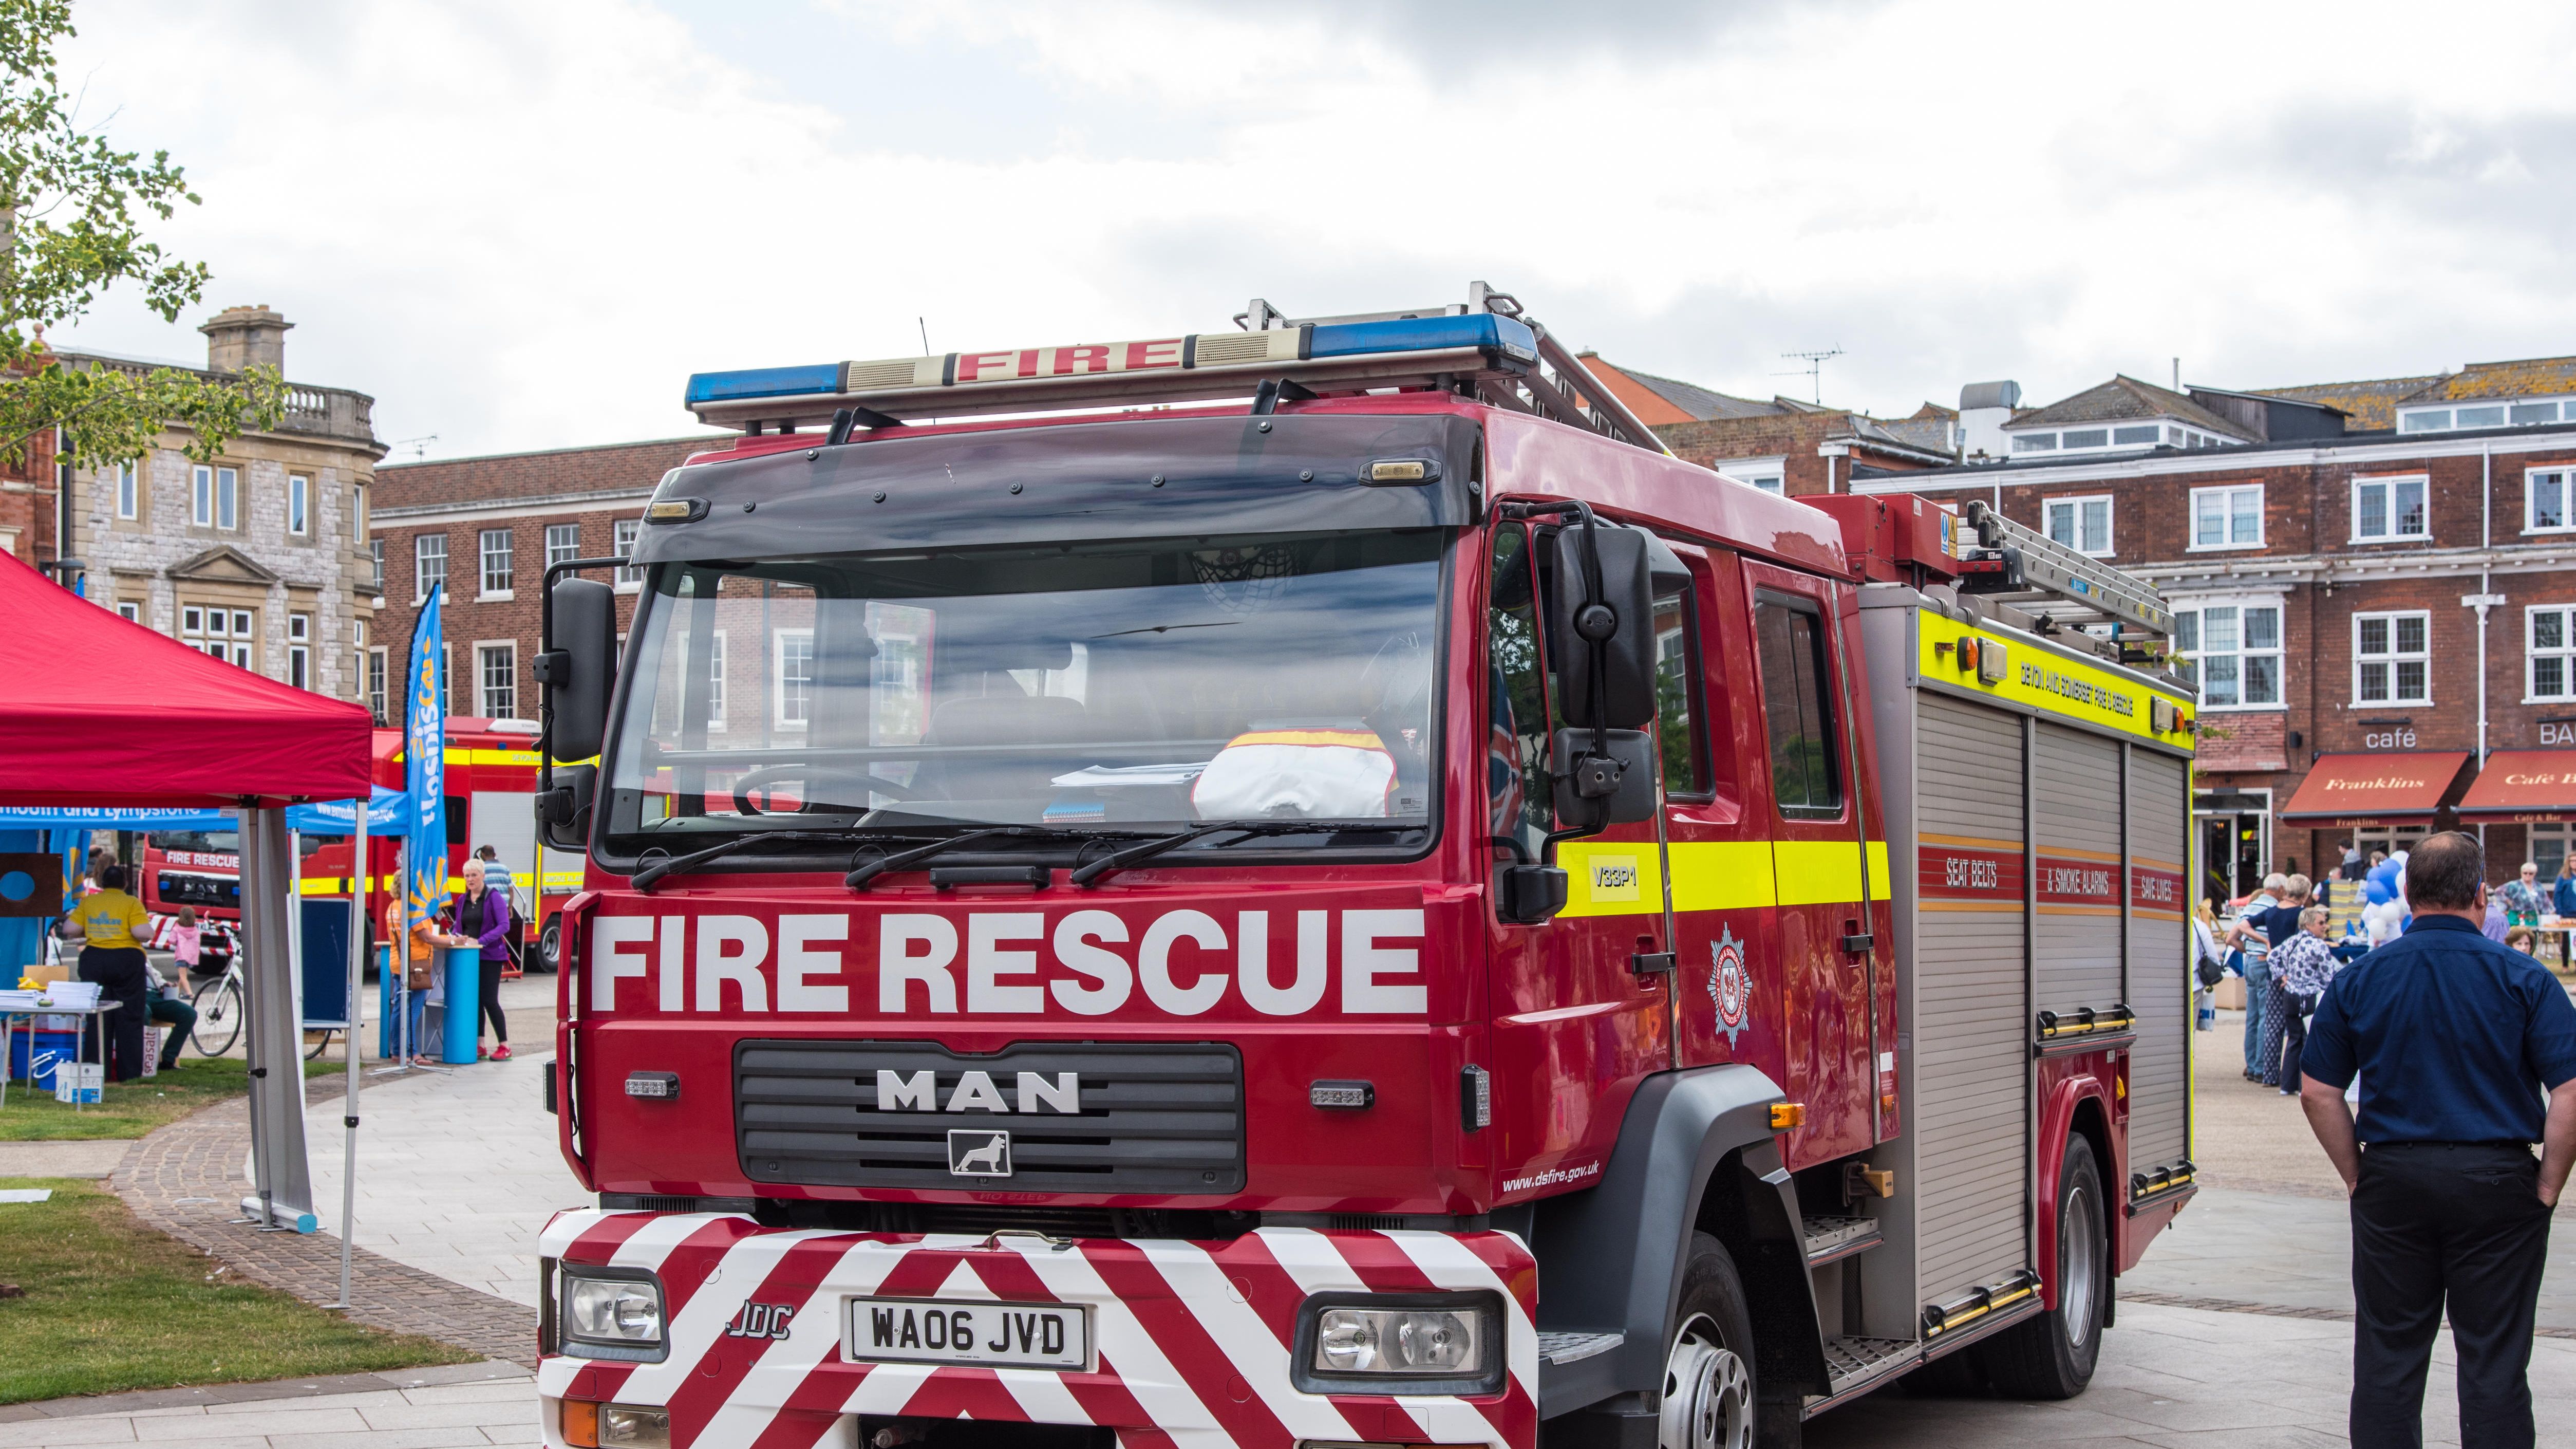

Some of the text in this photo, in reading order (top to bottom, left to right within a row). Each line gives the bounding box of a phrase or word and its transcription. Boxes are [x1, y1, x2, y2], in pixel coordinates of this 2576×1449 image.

[958, 339, 1181, 381] FIRE
[2021, 662, 2044, 690] DEVON
[2046, 670, 2059, 694] AND
[2061, 674, 2093, 705] SOMERSET
[2095, 685, 2107, 709] FIRE
[2113, 692, 2133, 717] RESCUE
[2366, 727, 2416, 748] café
[2540, 723, 2576, 744] BA
[512, 754, 531, 762] DEVON
[2324, 777, 2425, 790] Franklins
[2505, 773, 2555, 785] Café
[167, 851, 239, 868] FIRE RESCUE
[1947, 857, 1997, 889] SEAT BELTS
[185, 883, 217, 894] MAN
[1592, 866, 1636, 887] V33P1
[2047, 867, 2109, 896] & SMOKE ALARMS
[2141, 876, 2172, 902] SAVE LIVES
[592, 909, 1428, 1016] FIRE RESCUE
[1726, 949, 1742, 977] SOMERSET
[1723, 1013, 1737, 1024] RESCUE
[144, 1031, 156, 1074] seasalt
[877, 1070, 1081, 1114] MAN
[1503, 1160, 1600, 1192] www.dsfire.gov.uk
[725, 1299, 794, 1340] JDC
[871, 1307, 1064, 1355] WA06 JVD
